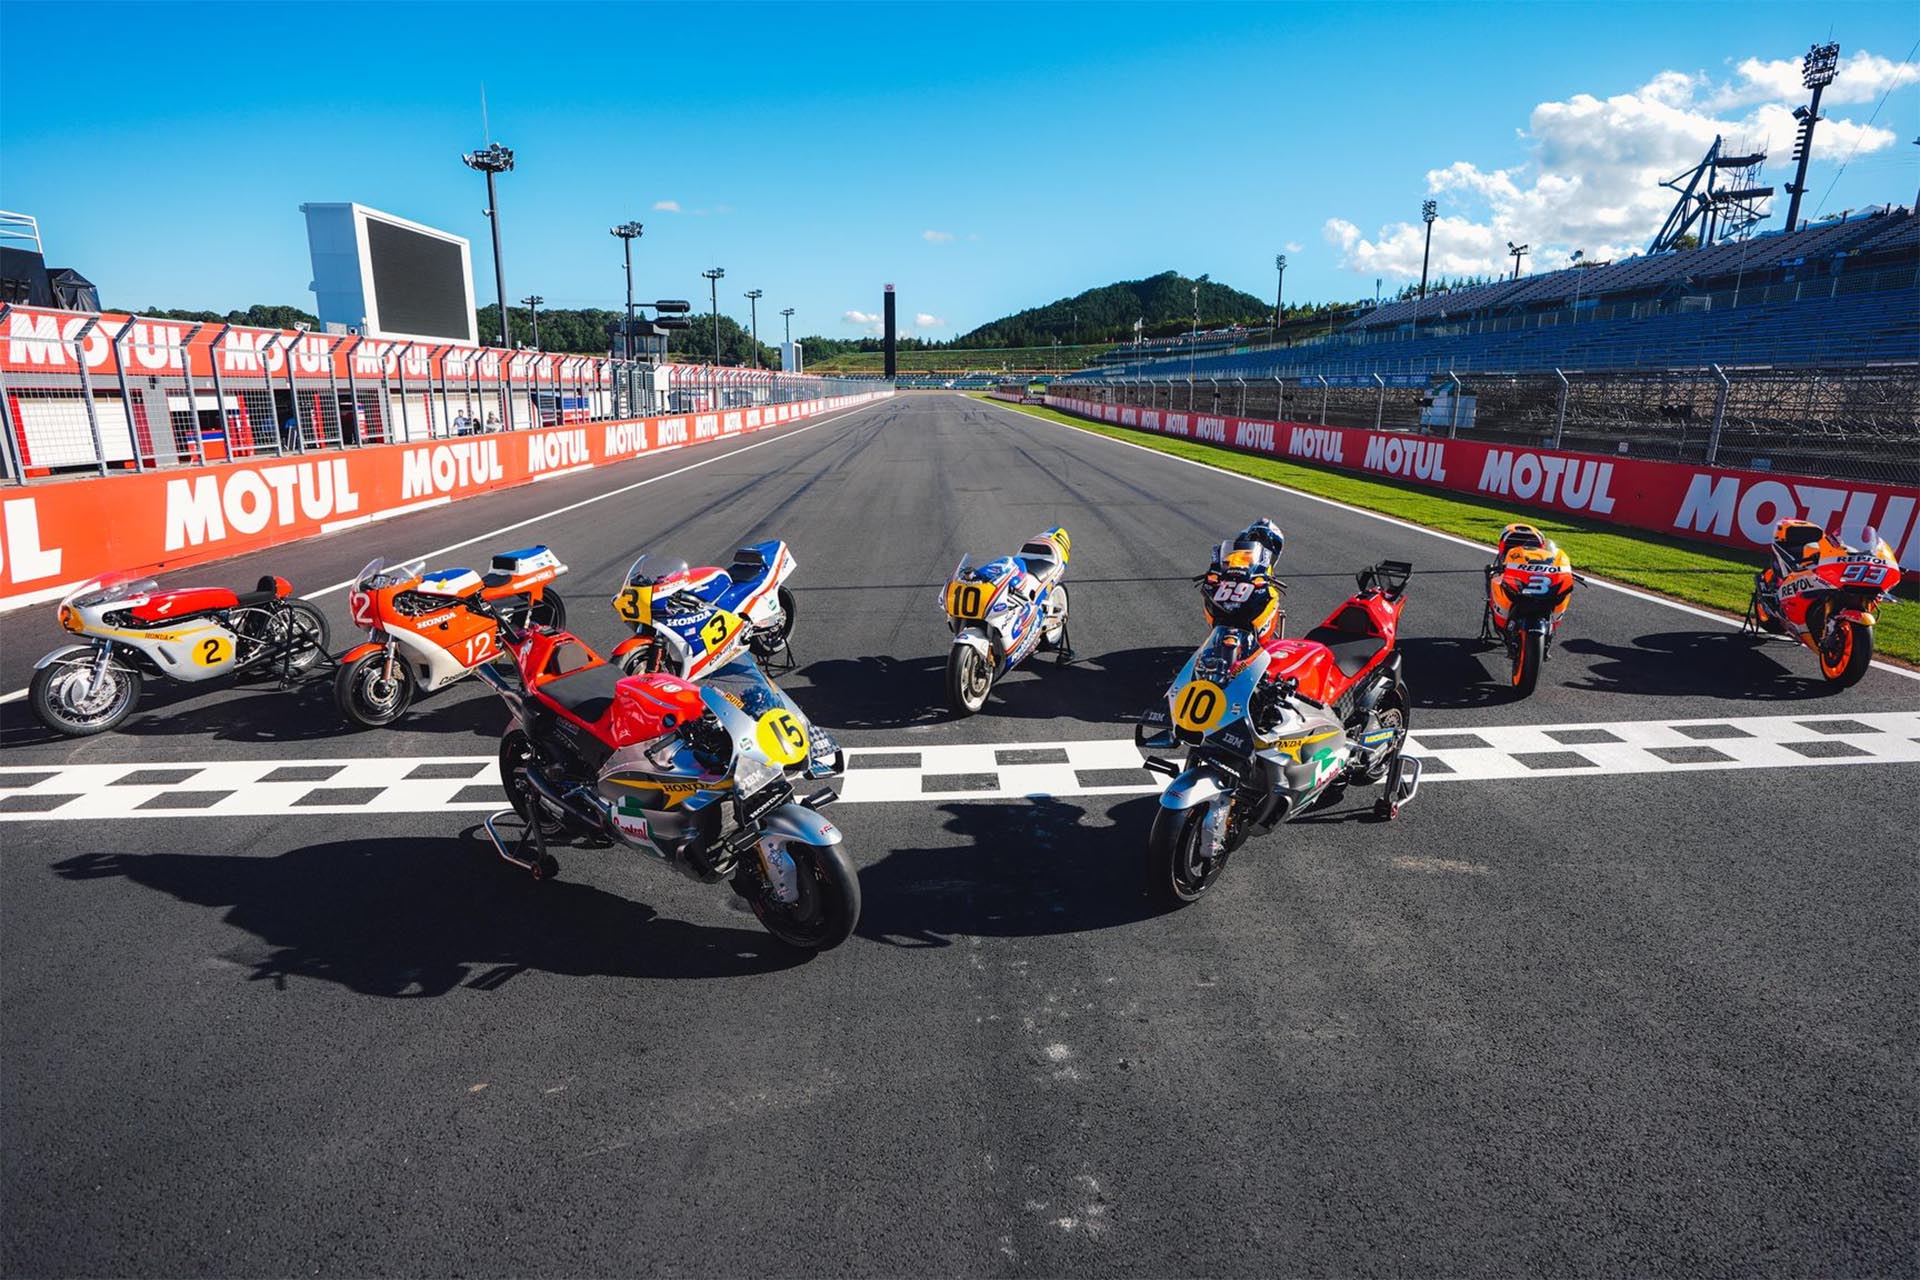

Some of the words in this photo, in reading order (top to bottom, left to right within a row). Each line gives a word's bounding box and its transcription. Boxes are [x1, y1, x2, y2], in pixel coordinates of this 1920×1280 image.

[10, 312, 191, 369] MOTUL
[224, 331, 335, 373] MOTUL
[356, 342, 431, 375] MOTUL
[604, 422, 648, 457] MOTUL
[657, 417, 688, 447] MOTUL
[1166, 413, 1188, 435] MOTUL
[1195, 417, 1225, 442] MOTUL
[1235, 421, 1275, 450] MOTUL
[528, 429, 589, 473] MOTUL
[1289, 427, 1343, 463] MOTUL
[1363, 435, 1446, 482] MOTUL
[402, 439, 503, 500] MOTUL
[1478, 449, 1616, 514] MOTUL
[165, 458, 359, 552] MOTUL
[1522, 575, 1552, 594] 3
[1840, 564, 1889, 585] 93
[621, 588, 640, 620] 3
[954, 585, 981, 617] 10
[1213, 581, 1255, 602] 69
[416, 611, 457, 629] HONDA
[666, 610, 713, 627] HONDA
[709, 614, 728, 645] 3
[203, 639, 222, 664] 2
[465, 632, 491, 665] 12
[725, 692, 745, 710] PUIG
[1148, 711, 1166, 722] IBM
[1179, 686, 1217, 725] 10
[769, 714, 805, 756] 15
[1222, 732, 1245, 748] IBM
[743, 770, 764, 788] IBM
[749, 793, 784, 819] HONDA
